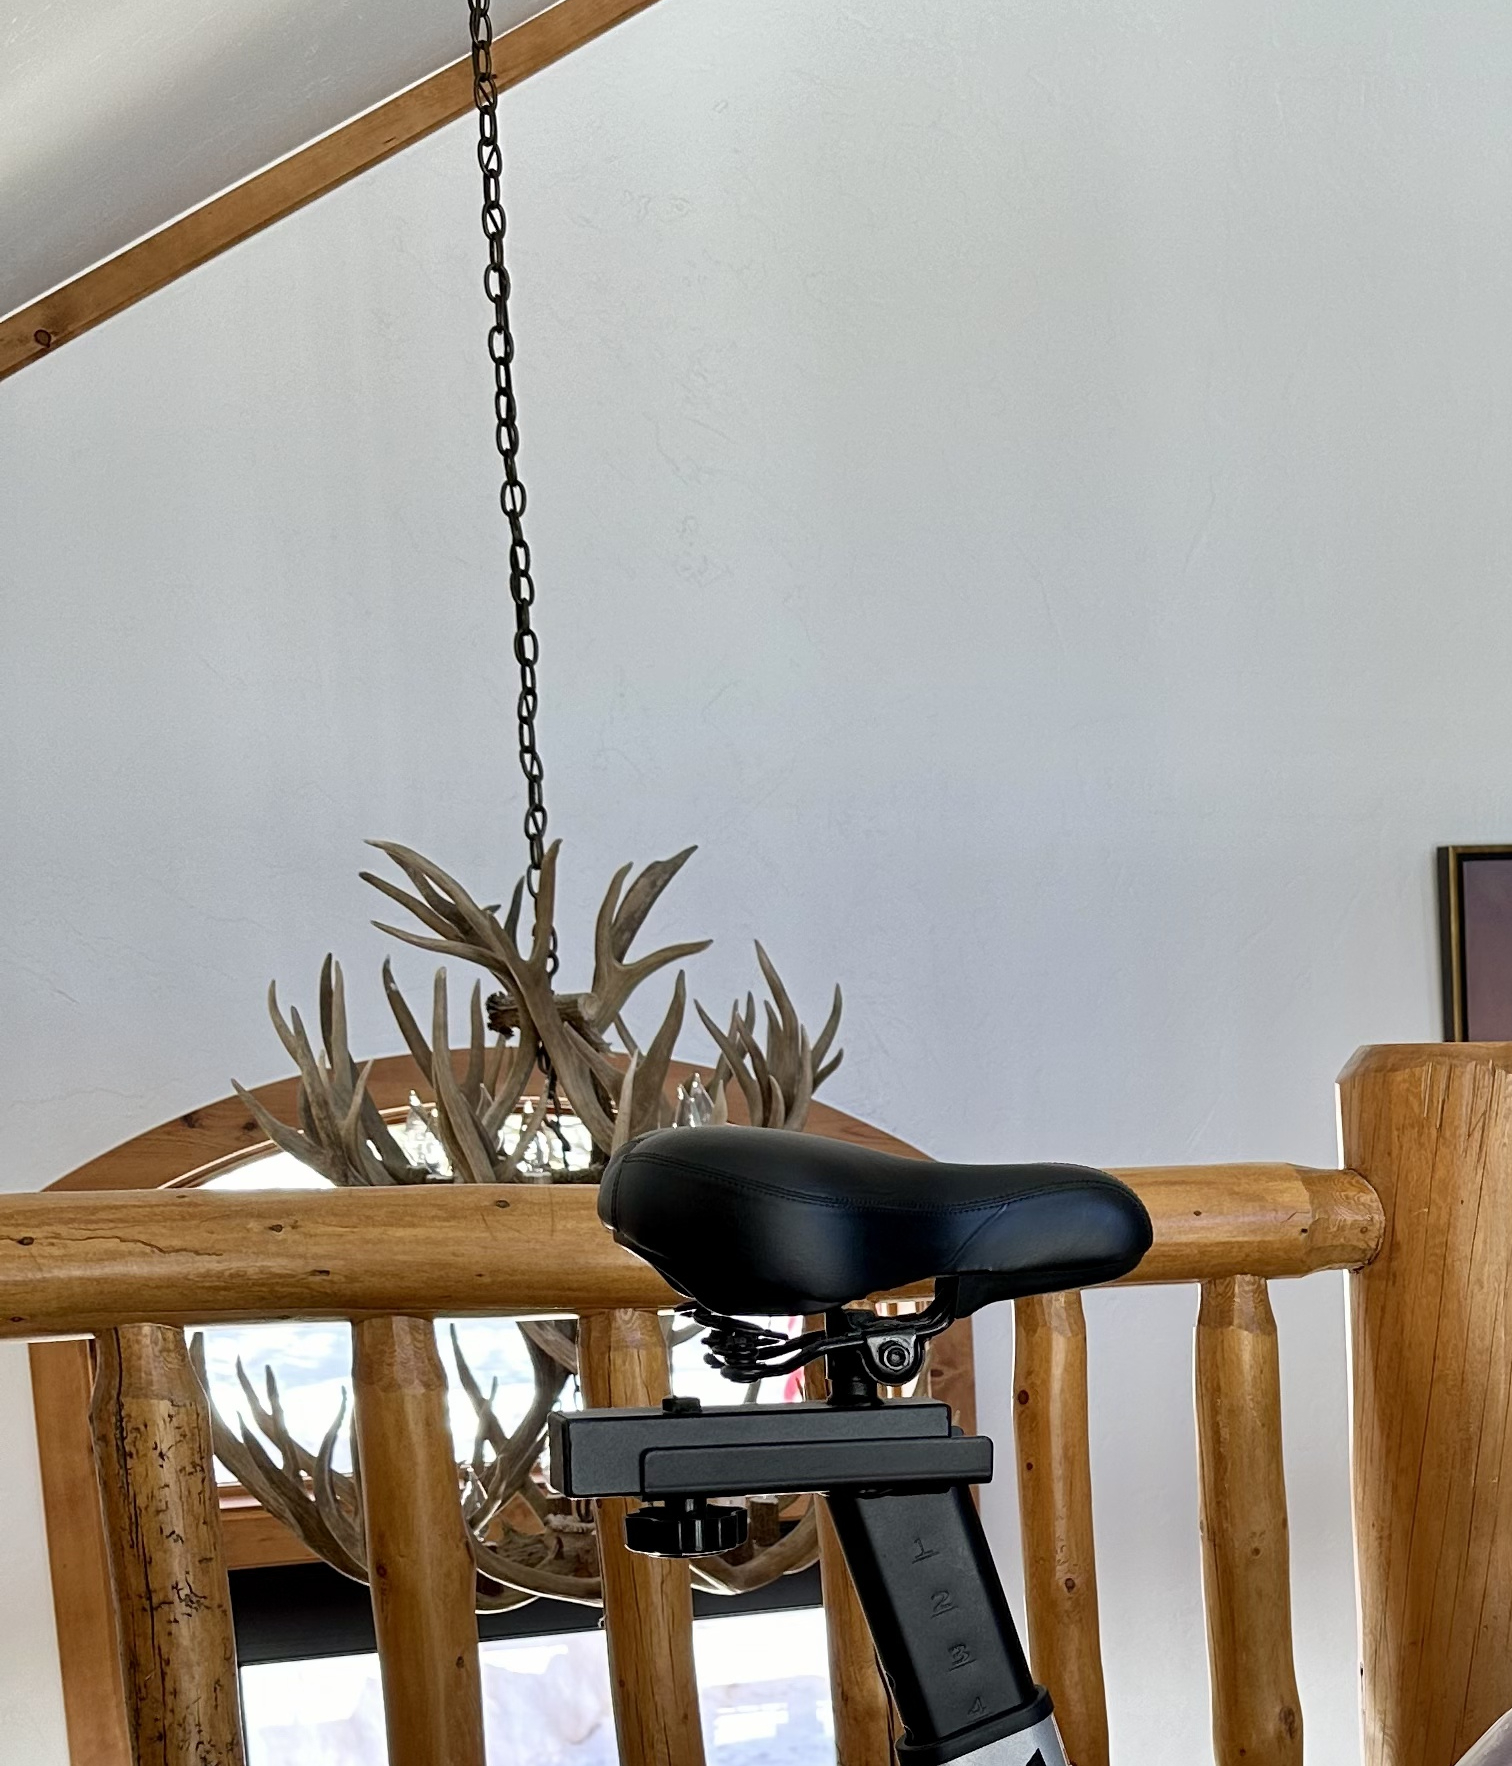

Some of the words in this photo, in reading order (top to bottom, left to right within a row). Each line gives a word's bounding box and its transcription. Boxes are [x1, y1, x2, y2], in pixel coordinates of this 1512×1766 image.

[914, 1537, 937, 1561] 1
[930, 1590, 955, 1615] 2
[948, 1643, 973, 1668] 3
[966, 1696, 988, 1719] 4
